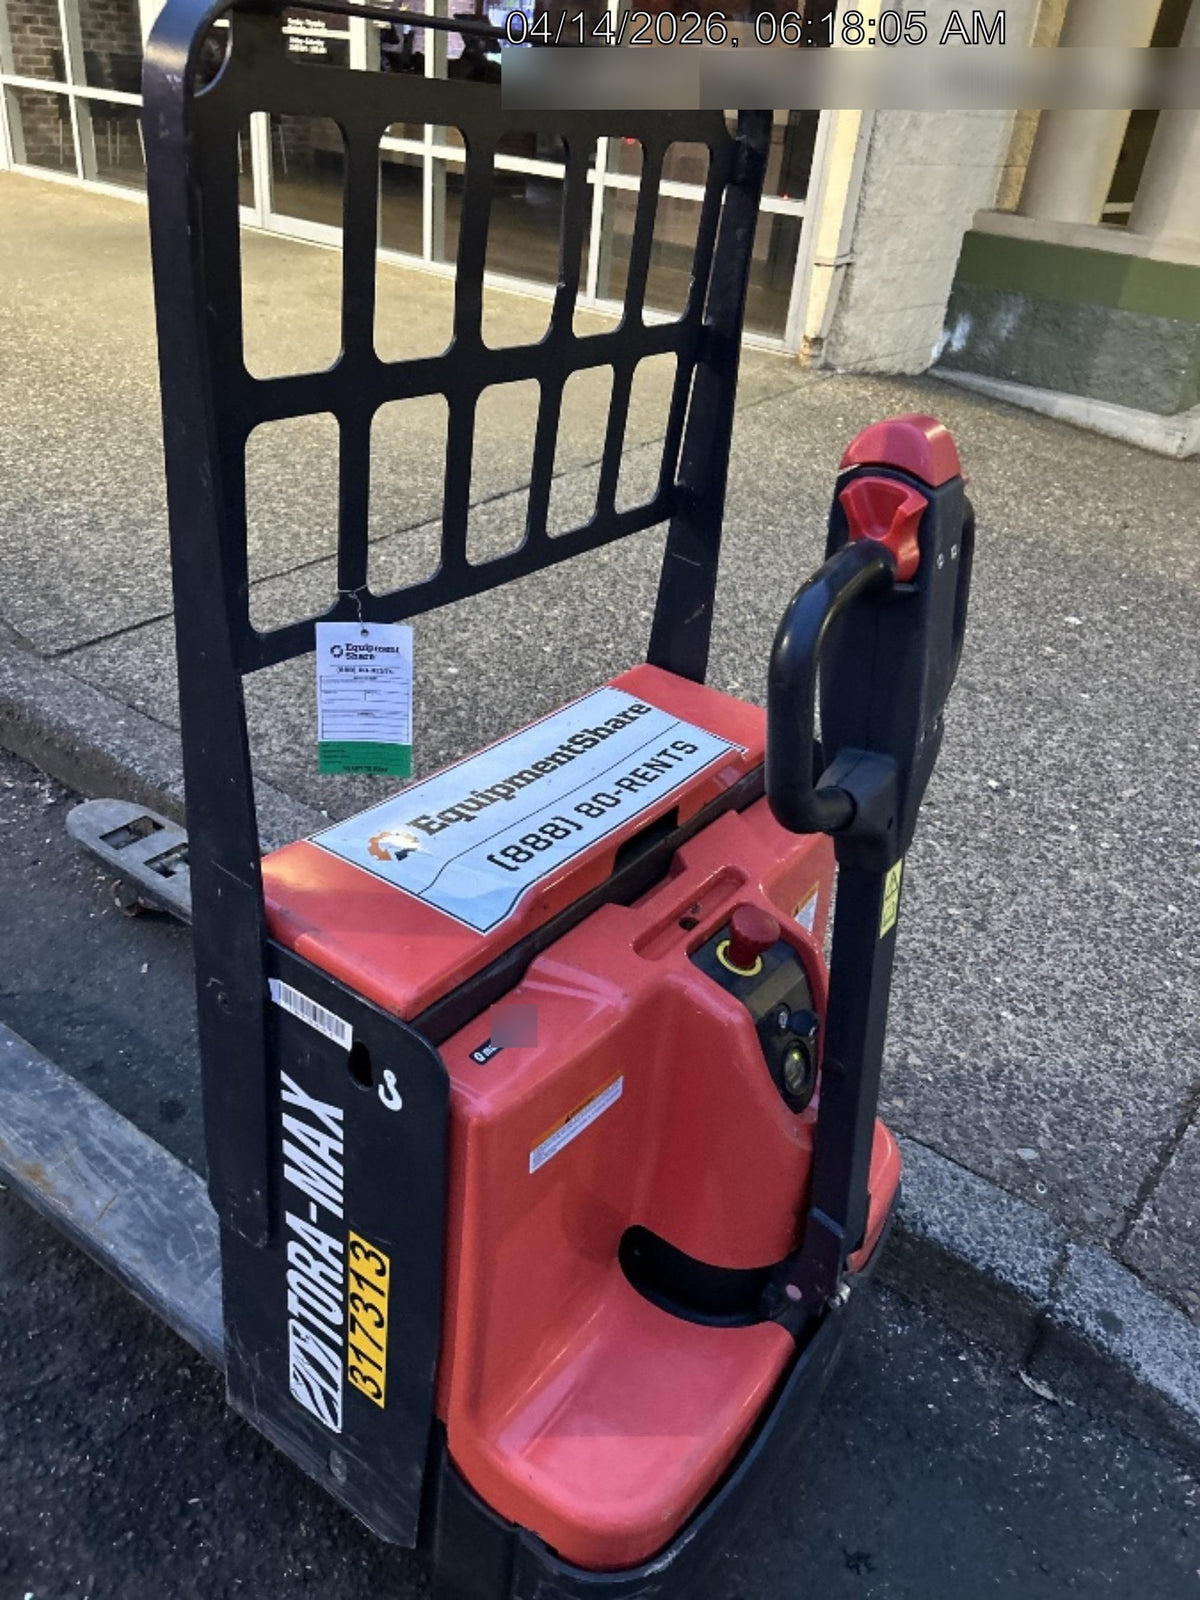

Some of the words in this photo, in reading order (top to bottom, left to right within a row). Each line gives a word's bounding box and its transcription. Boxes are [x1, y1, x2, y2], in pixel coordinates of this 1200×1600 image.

[407, 700, 652, 836] EquipmentShare
[486, 816, 584, 872] (888)
[574, 740, 700, 818] 80-RENTS
[280, 1069, 344, 1347] TORA-MAX
[350, 1240, 387, 1401] 317313
